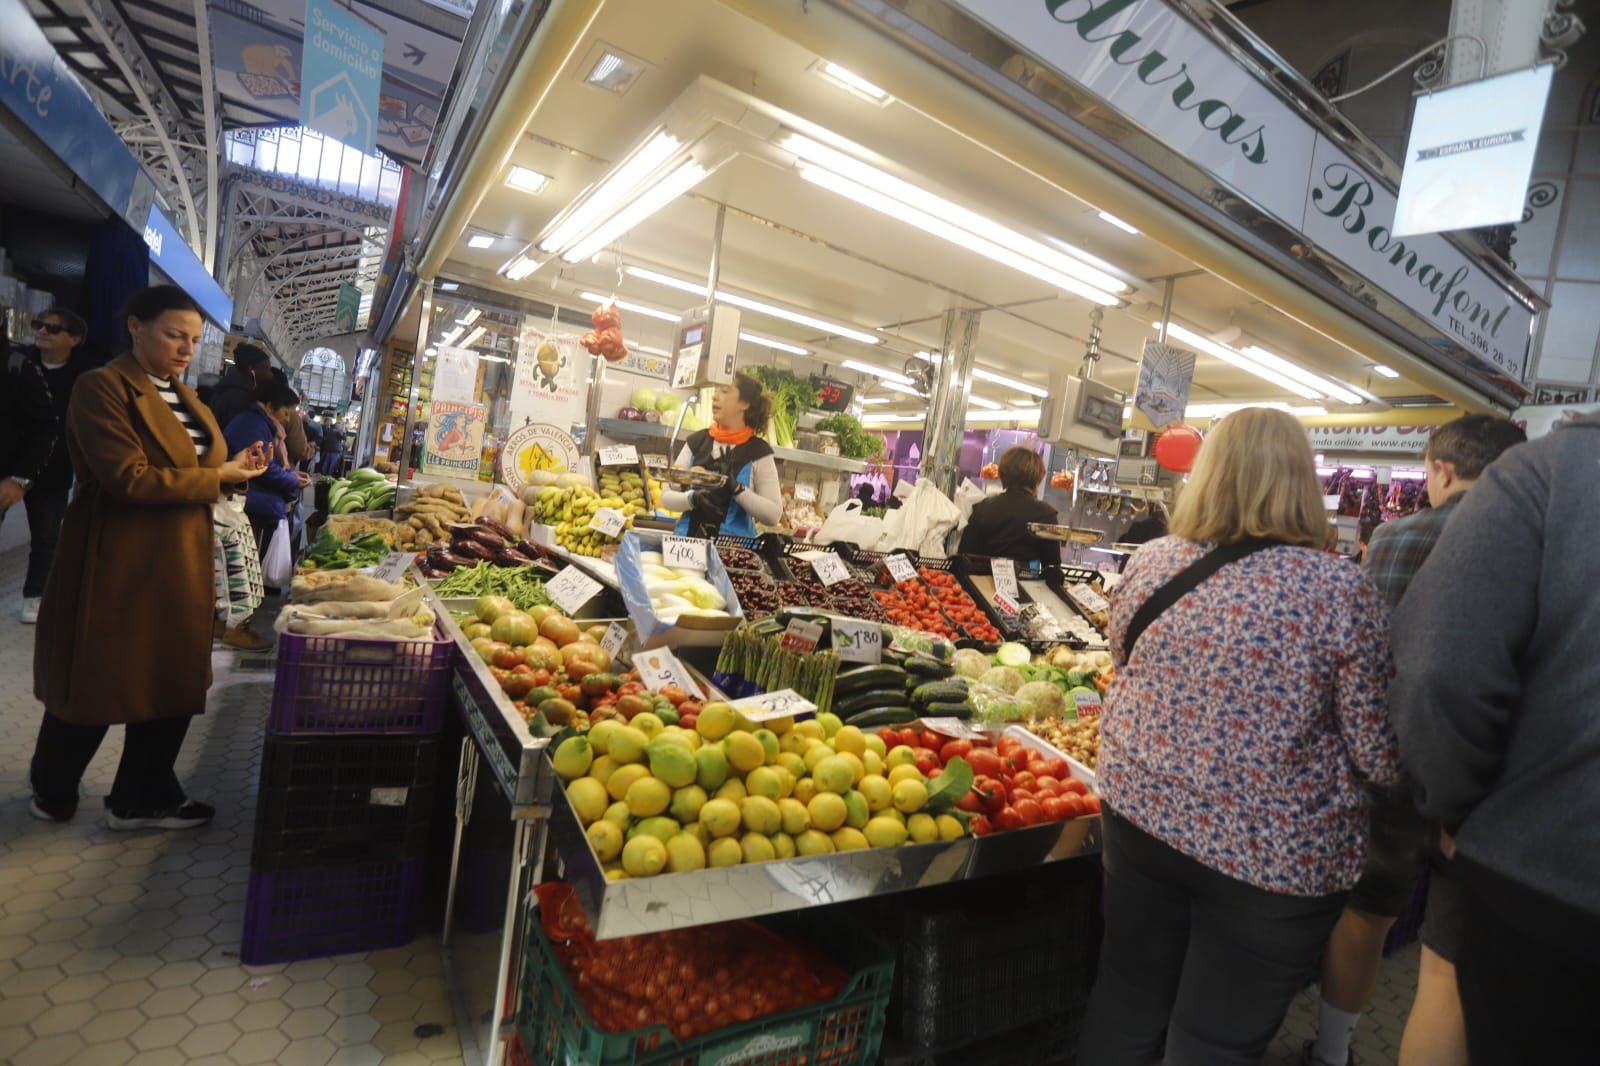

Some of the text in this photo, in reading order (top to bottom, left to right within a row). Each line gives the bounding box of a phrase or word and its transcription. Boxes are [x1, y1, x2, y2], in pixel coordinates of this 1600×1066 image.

[312, 7, 369, 55] Servicio
[312, 31, 377, 80] domicilio
[1311, 162, 1511, 339] Bonafont
[431, 400, 486, 423] PRINCIPIS
[505, 426, 575, 457] ARROS DE VALENCIA
[1334, 438, 1365, 448] online
[441, 456, 479, 472] PRINCIPIS
[853, 628, 880, 651] 1'80
